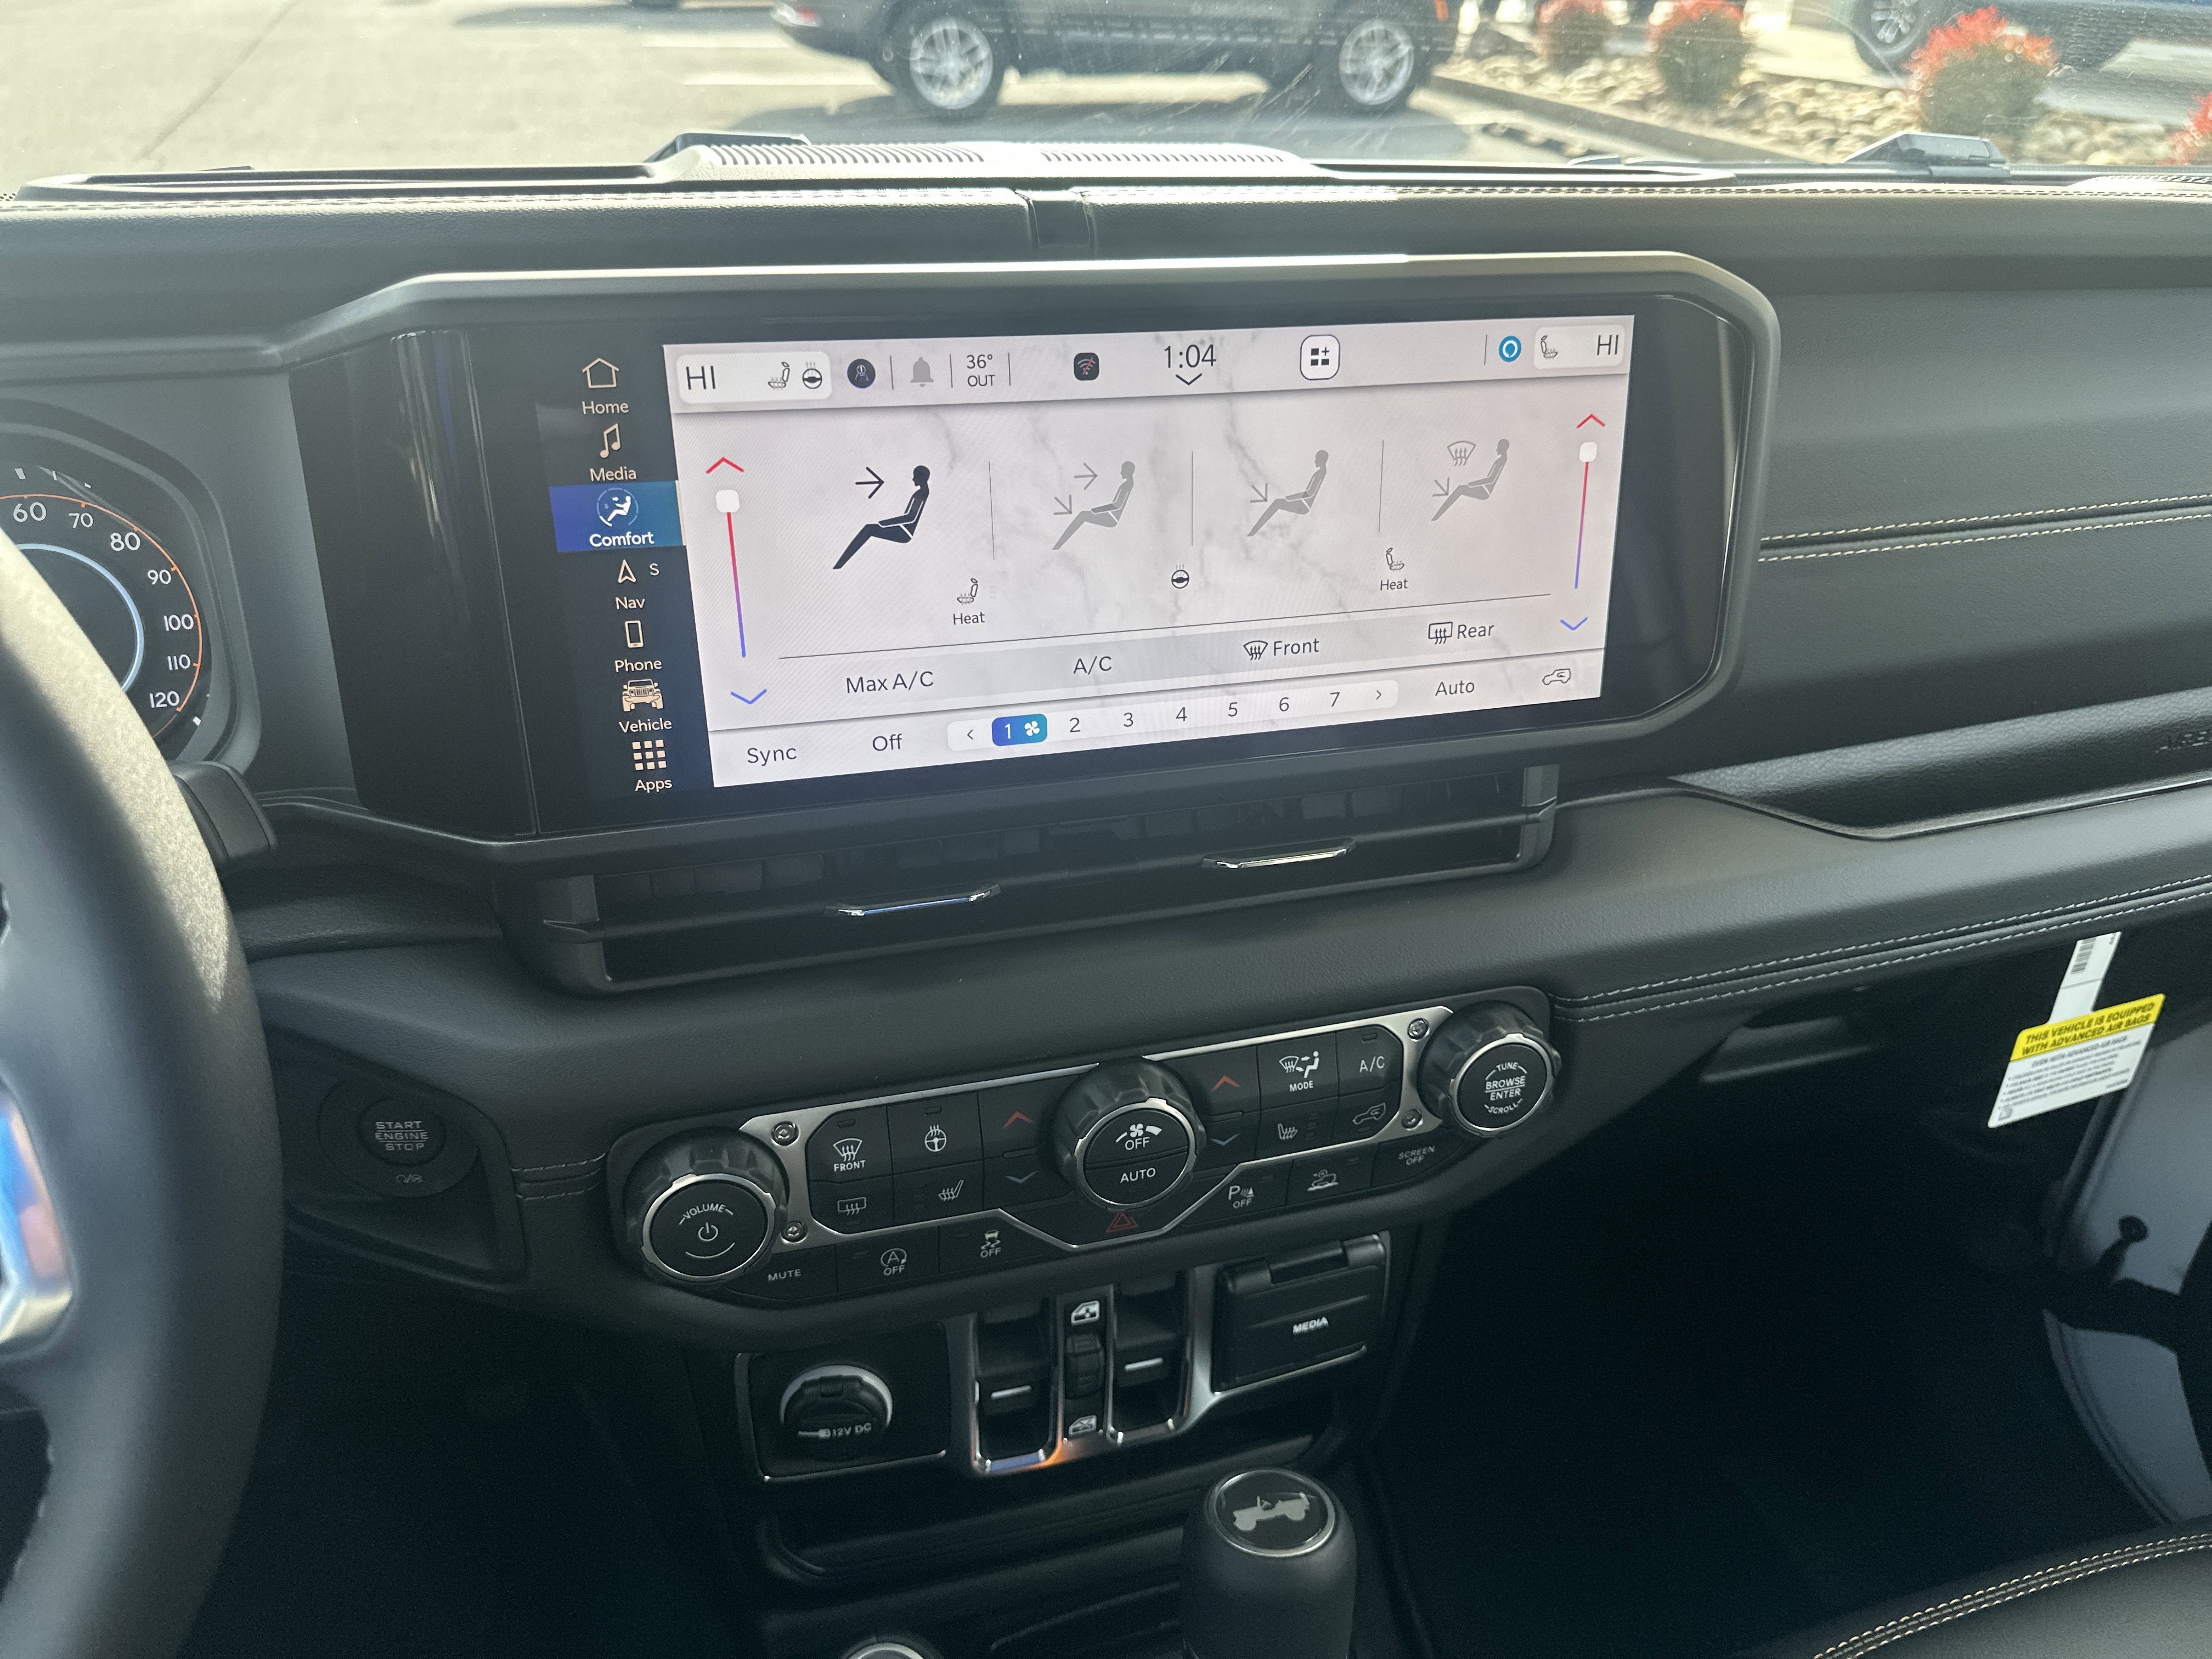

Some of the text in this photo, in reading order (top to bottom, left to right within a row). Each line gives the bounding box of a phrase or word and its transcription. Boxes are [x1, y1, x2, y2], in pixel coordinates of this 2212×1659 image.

[1596, 334, 1619, 356] HI
[966, 354, 993, 370] 36°
[1164, 344, 1217, 369] 1:04
[686, 365, 716, 390] HI
[967, 374, 995, 387] OUT
[582, 400, 629, 414] Home
[590, 467, 637, 482] Media
[13, 502, 47, 523] 60
[68, 512, 94, 528] 70
[110, 532, 141, 551] 80
[589, 532, 654, 548] Comfort
[147, 569, 172, 585] 90
[649, 563, 660, 577] S
[1380, 578, 1408, 591] Heat
[616, 597, 645, 610] Nav
[163, 614, 194, 631] 100
[952, 611, 985, 626] Heat
[1457, 623, 1494, 640] Rear
[1273, 637, 1319, 657] Front
[167, 654, 191, 670] 110
[614, 659, 662, 673] Phone
[1073, 656, 1113, 675] A/C
[845, 670, 934, 695] Max A/C
[1435, 679, 1475, 697] Auto
[149, 691, 180, 708] 120
[1005, 691, 1341, 740] 1 2 3 4 5 6 7
[619, 718, 672, 733] Vehicle
[872, 733, 903, 752] Off
[747, 745, 797, 766] Sync
[635, 778, 673, 793] Apps
[2025, 1002, 2155, 1043] THIS VEHICLE IS EQUIPPED
[2022, 1013, 2151, 1056] WITH ADVANCED AIR BAGS
[1359, 1056, 1385, 1073] A/C
[1496, 1062, 1519, 1071] TUNE
[1289, 1080, 1314, 1092] MODE
[1486, 1075, 1526, 1090] BROWSE
[1490, 1087, 1521, 1101] ENTER
[1488, 1103, 1518, 1114] SCROLL
[375, 1121, 422, 1130] START
[375, 1132, 428, 1141] ENGINE
[1125, 1136, 1150, 1150] OFF
[386, 1143, 425, 1151] STOP
[1398, 1146, 1436, 1160] SCREEN
[833, 1159, 866, 1172] FRONT
[1406, 1155, 1424, 1166] OFF
[1120, 1167, 1156, 1183] AUTO
[682, 1203, 726, 1219] VOLUME
[1233, 1198, 1252, 1209] OFF
[980, 1248, 1002, 1258] OFF
[768, 1269, 802, 1282] MUTE
[884, 1265, 906, 1276] OFF
[1293, 1317, 1329, 1334] MEDIA
[832, 1423, 872, 1437] 12V DC
